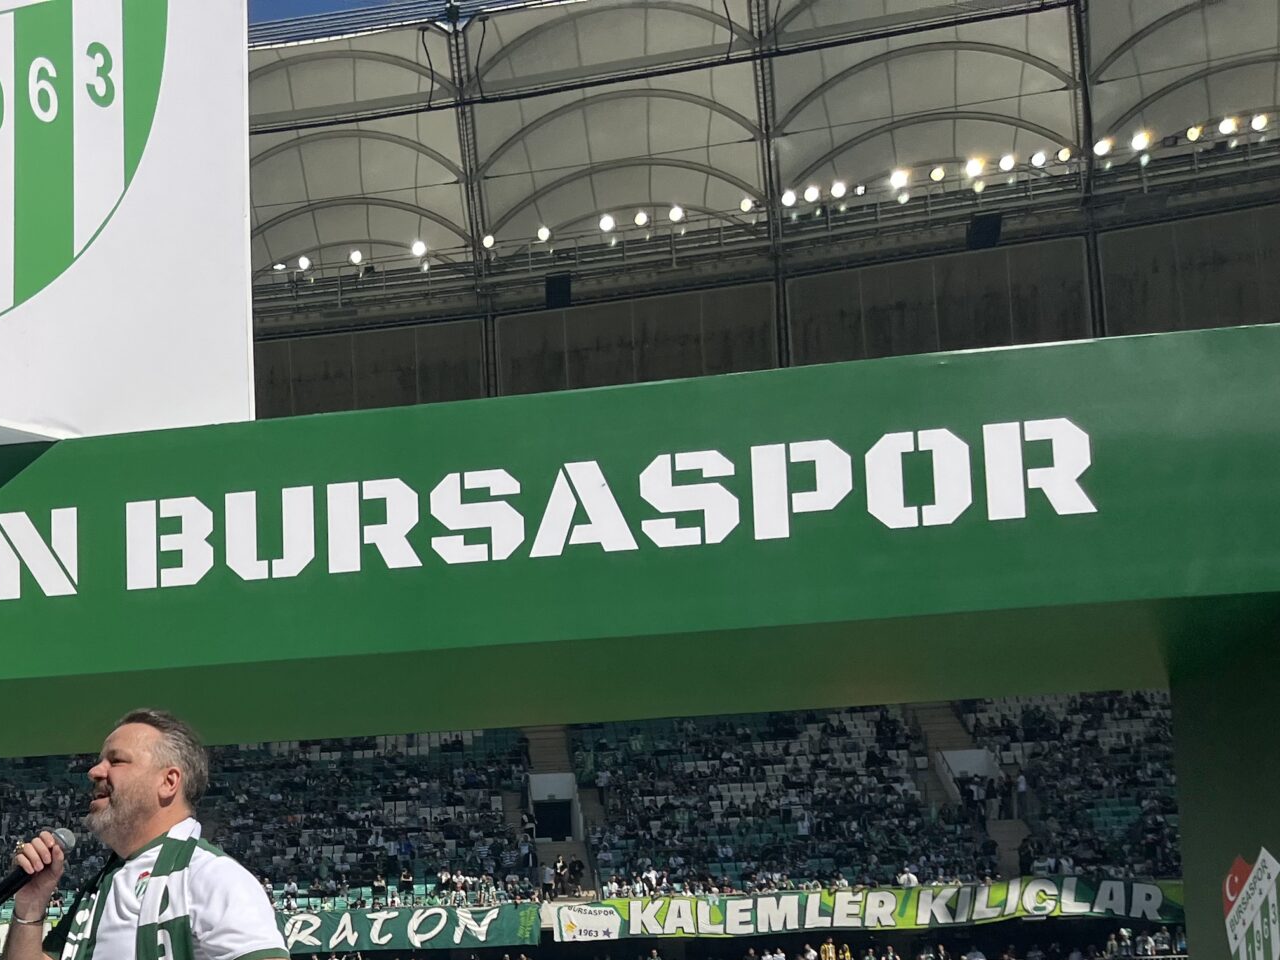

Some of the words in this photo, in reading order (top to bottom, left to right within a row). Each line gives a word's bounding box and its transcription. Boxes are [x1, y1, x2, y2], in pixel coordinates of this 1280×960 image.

[125, 416, 1098, 591] BURSASPOR
[578, 928, 599, 938] 1963
[628, 890, 897, 935] KALEMLER
